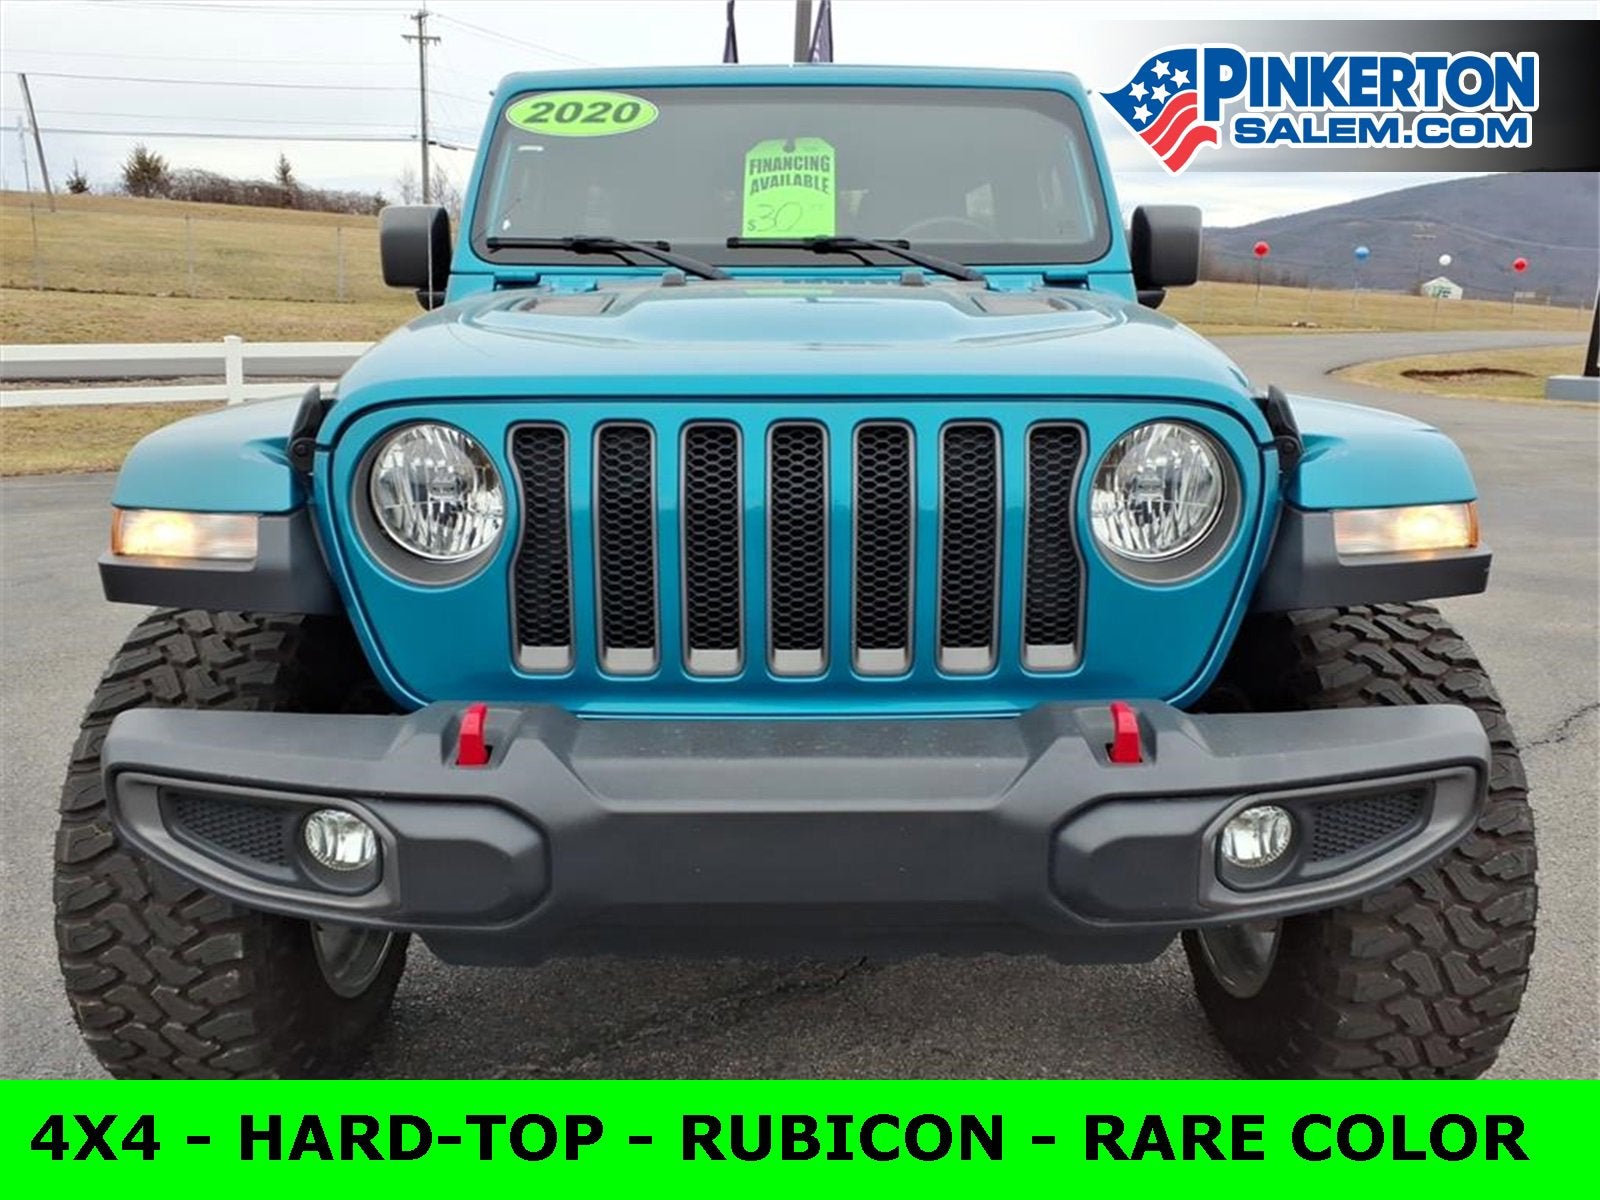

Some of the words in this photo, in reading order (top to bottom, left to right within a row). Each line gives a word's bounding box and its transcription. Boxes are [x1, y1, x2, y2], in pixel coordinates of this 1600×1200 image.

[522, 101, 641, 124] 2020
[750, 155, 830, 175] FINANCING
[750, 174, 830, 196] AVAILABLE
